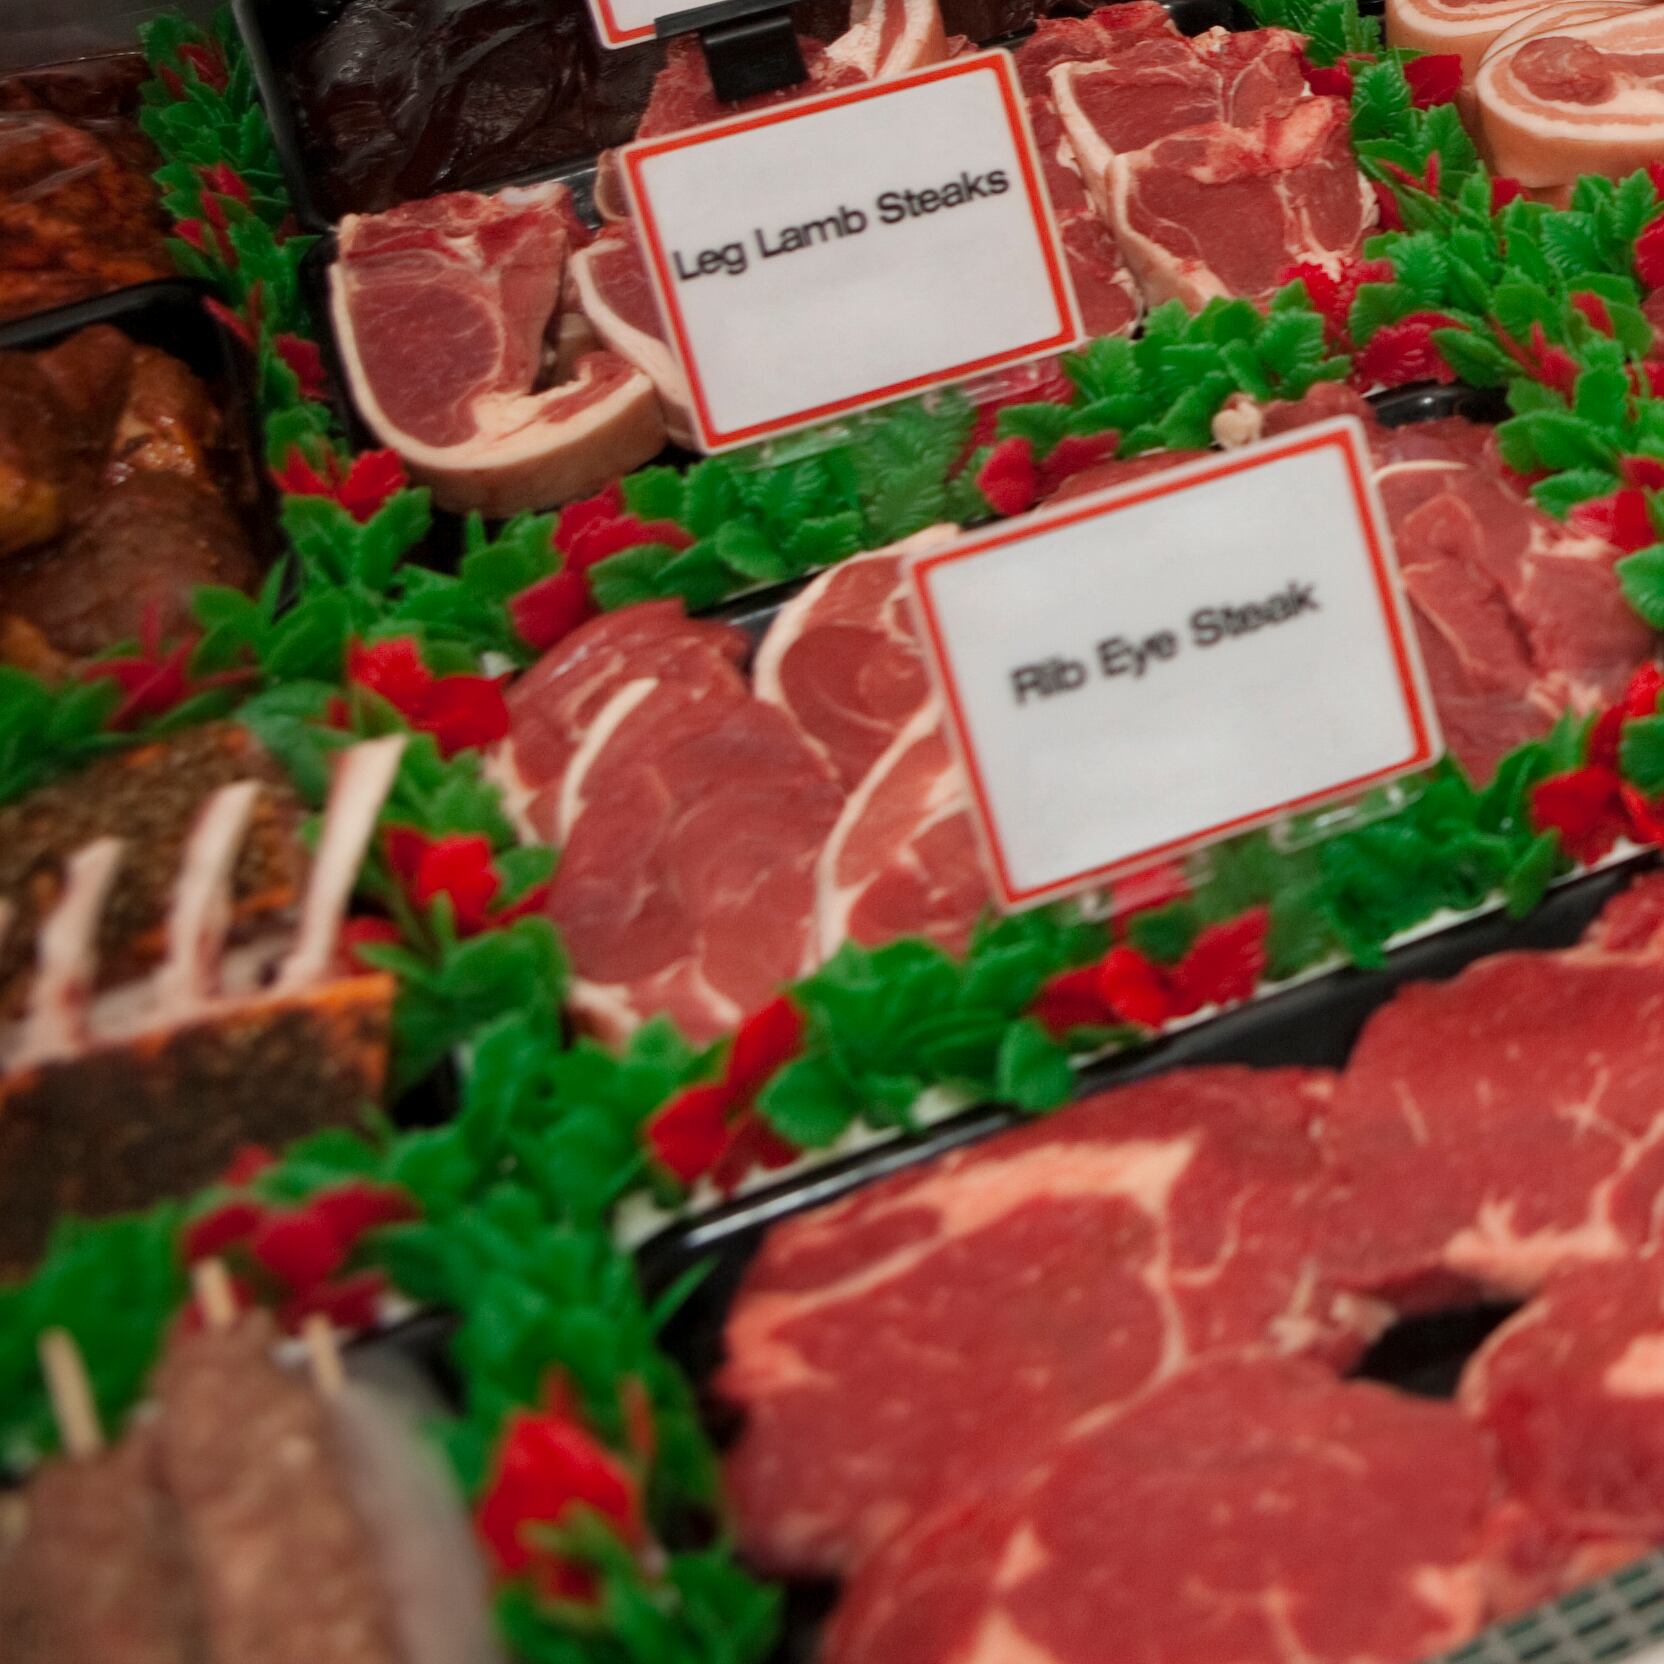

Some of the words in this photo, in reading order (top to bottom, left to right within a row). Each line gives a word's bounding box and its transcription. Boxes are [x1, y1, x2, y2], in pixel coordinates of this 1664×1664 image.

[672, 240, 749, 282] Leg
[754, 205, 868, 259] Lamb
[875, 168, 1010, 225] Steaks
[1008, 655, 1089, 705] Rib
[1094, 629, 1180, 680] Eye
[1188, 582, 1320, 650] Steak
